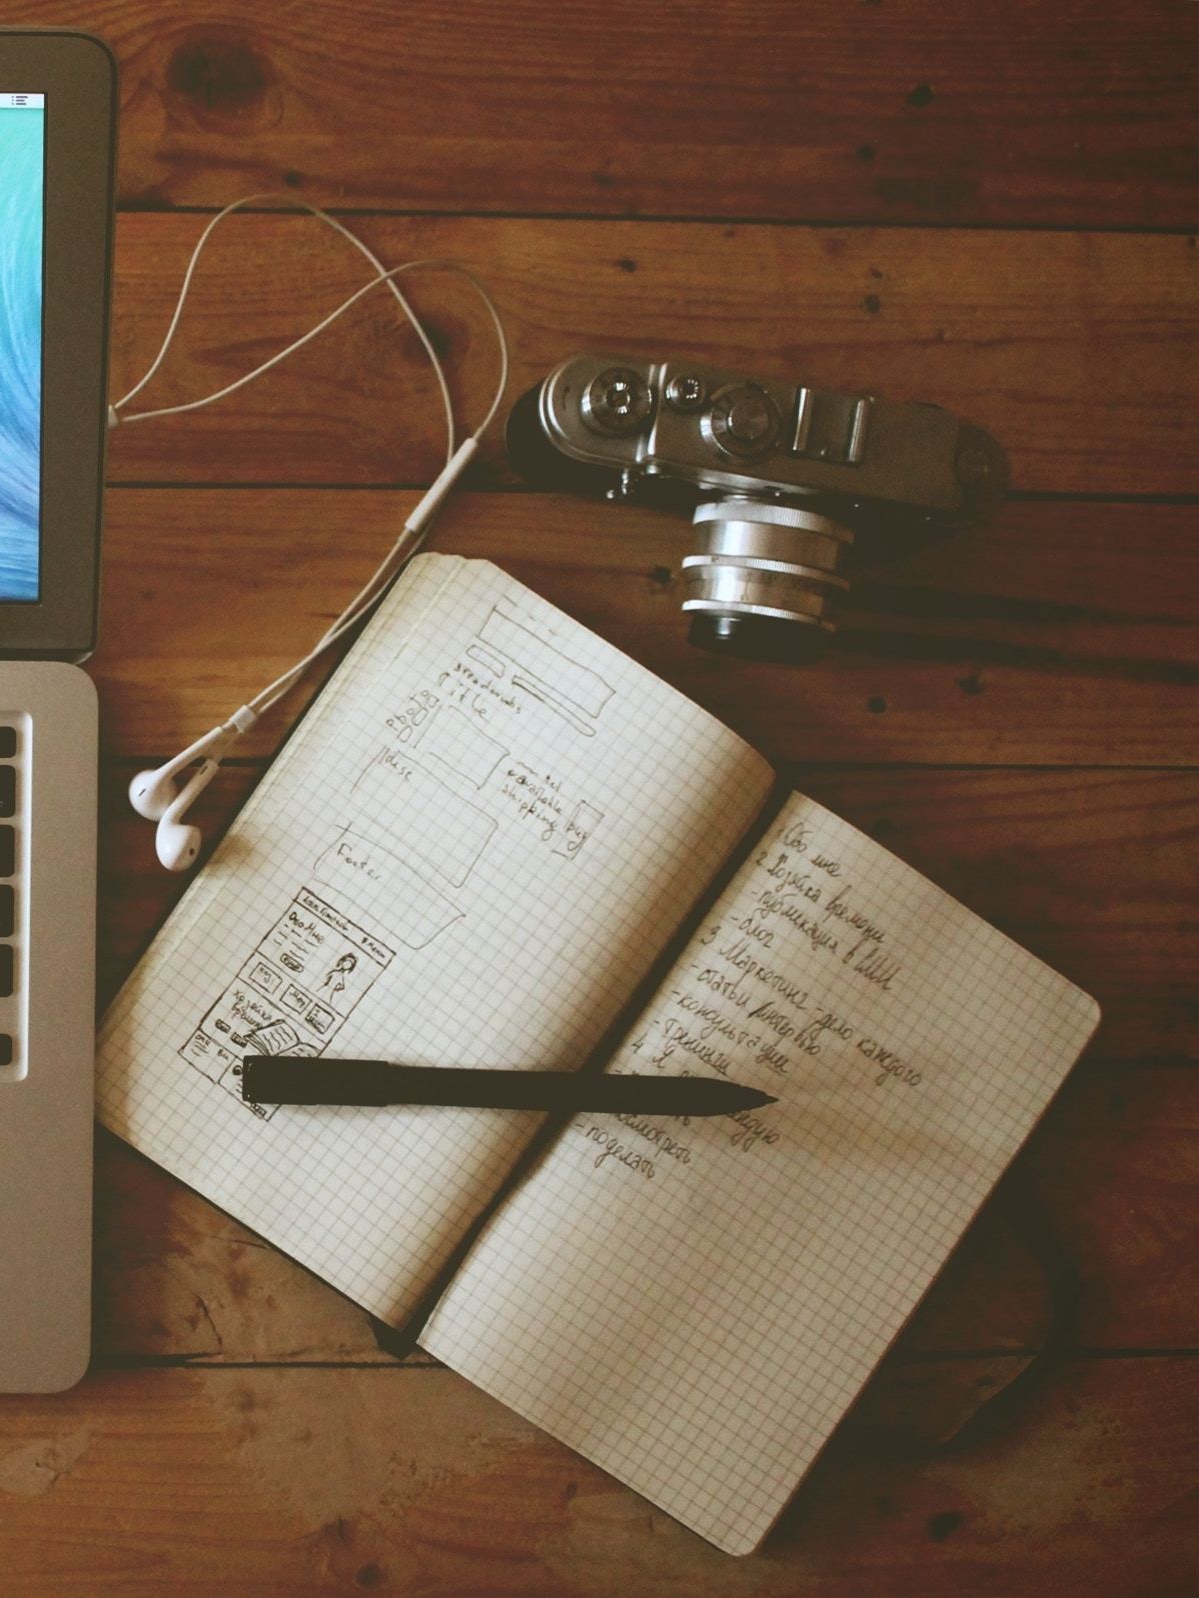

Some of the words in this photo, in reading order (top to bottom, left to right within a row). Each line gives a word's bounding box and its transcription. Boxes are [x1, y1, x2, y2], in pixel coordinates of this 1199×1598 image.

[756, 851, 768, 867] 2
[810, 854, 843, 878] мне
[701, 926, 721, 946] 3
[719, 941, 810, 1010] Маркетинг
[856, 1034, 923, 1087] каждого
[632, 1034, 649, 1054] 4
